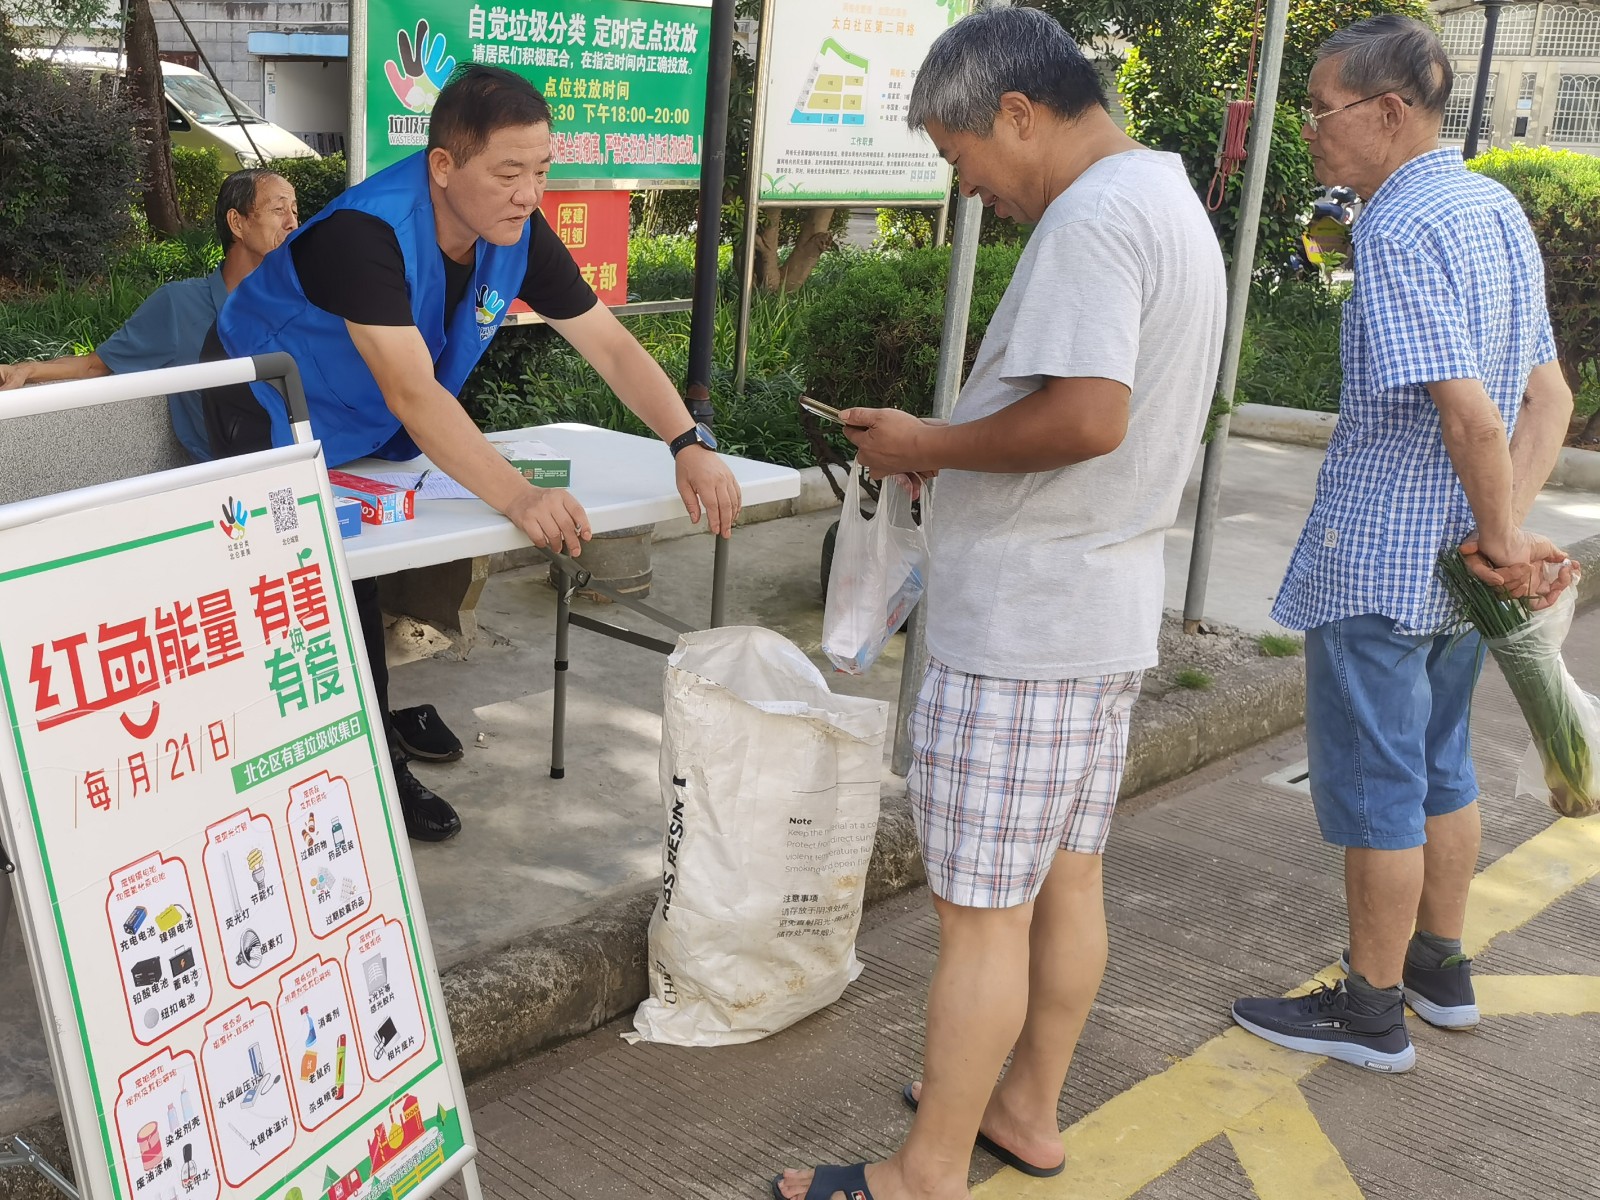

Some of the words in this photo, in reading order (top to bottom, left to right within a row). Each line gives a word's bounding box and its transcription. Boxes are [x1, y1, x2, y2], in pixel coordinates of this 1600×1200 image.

[468, 4, 587, 46] 自觉垃圾分类
[592, 16, 698, 53] 定时定点投放
[543, 76, 630, 100] 点位投放时间
[561, 206, 584, 224] 党建
[561, 226, 584, 244] 引领
[29, 588, 245, 732] 红色能量
[249, 562, 331, 646] 有害
[264, 628, 345, 718] 有爱
[243, 716, 362, 786] 北仑区有害垃圾收集日
[83, 767, 112, 812] 每
[129, 751, 151, 798] 月
[165, 733, 196, 781] 21
[208, 719, 230, 762] 日
[789, 817, 812, 825] Note
[667, 798, 685, 868] RESIN
[786, 840, 816, 850] Protect
[830, 835, 854, 844] direct
[788, 829, 809, 838] Keep
[810, 828, 823, 836] the
[300, 839, 328, 861] 过期药物
[785, 852, 813, 861] violent
[785, 864, 820, 875] Smoking
[834, 859, 856, 869] open
[250, 885, 275, 906] 节能灯
[317, 890, 332, 904] 药片
[783, 894, 818, 903] 注意事项
[225, 908, 250, 930] 荧光灯
[120, 925, 157, 952] 充电电池
[260, 933, 284, 955] 卤素灯
[172, 968, 199, 991] 蓄电池
[132, 977, 170, 1006] 铅酸电池
[160, 993, 196, 1020] 纽扣电池
[317, 1007, 341, 1029] 消毒剂
[387, 1035, 415, 1061] 相片底片
[309, 1062, 332, 1084] 老鼠药
[249, 1115, 289, 1151] 水银体温计
[136, 1156, 173, 1191] 废油漆桶
[184, 1168, 211, 1194] 洗甲水
